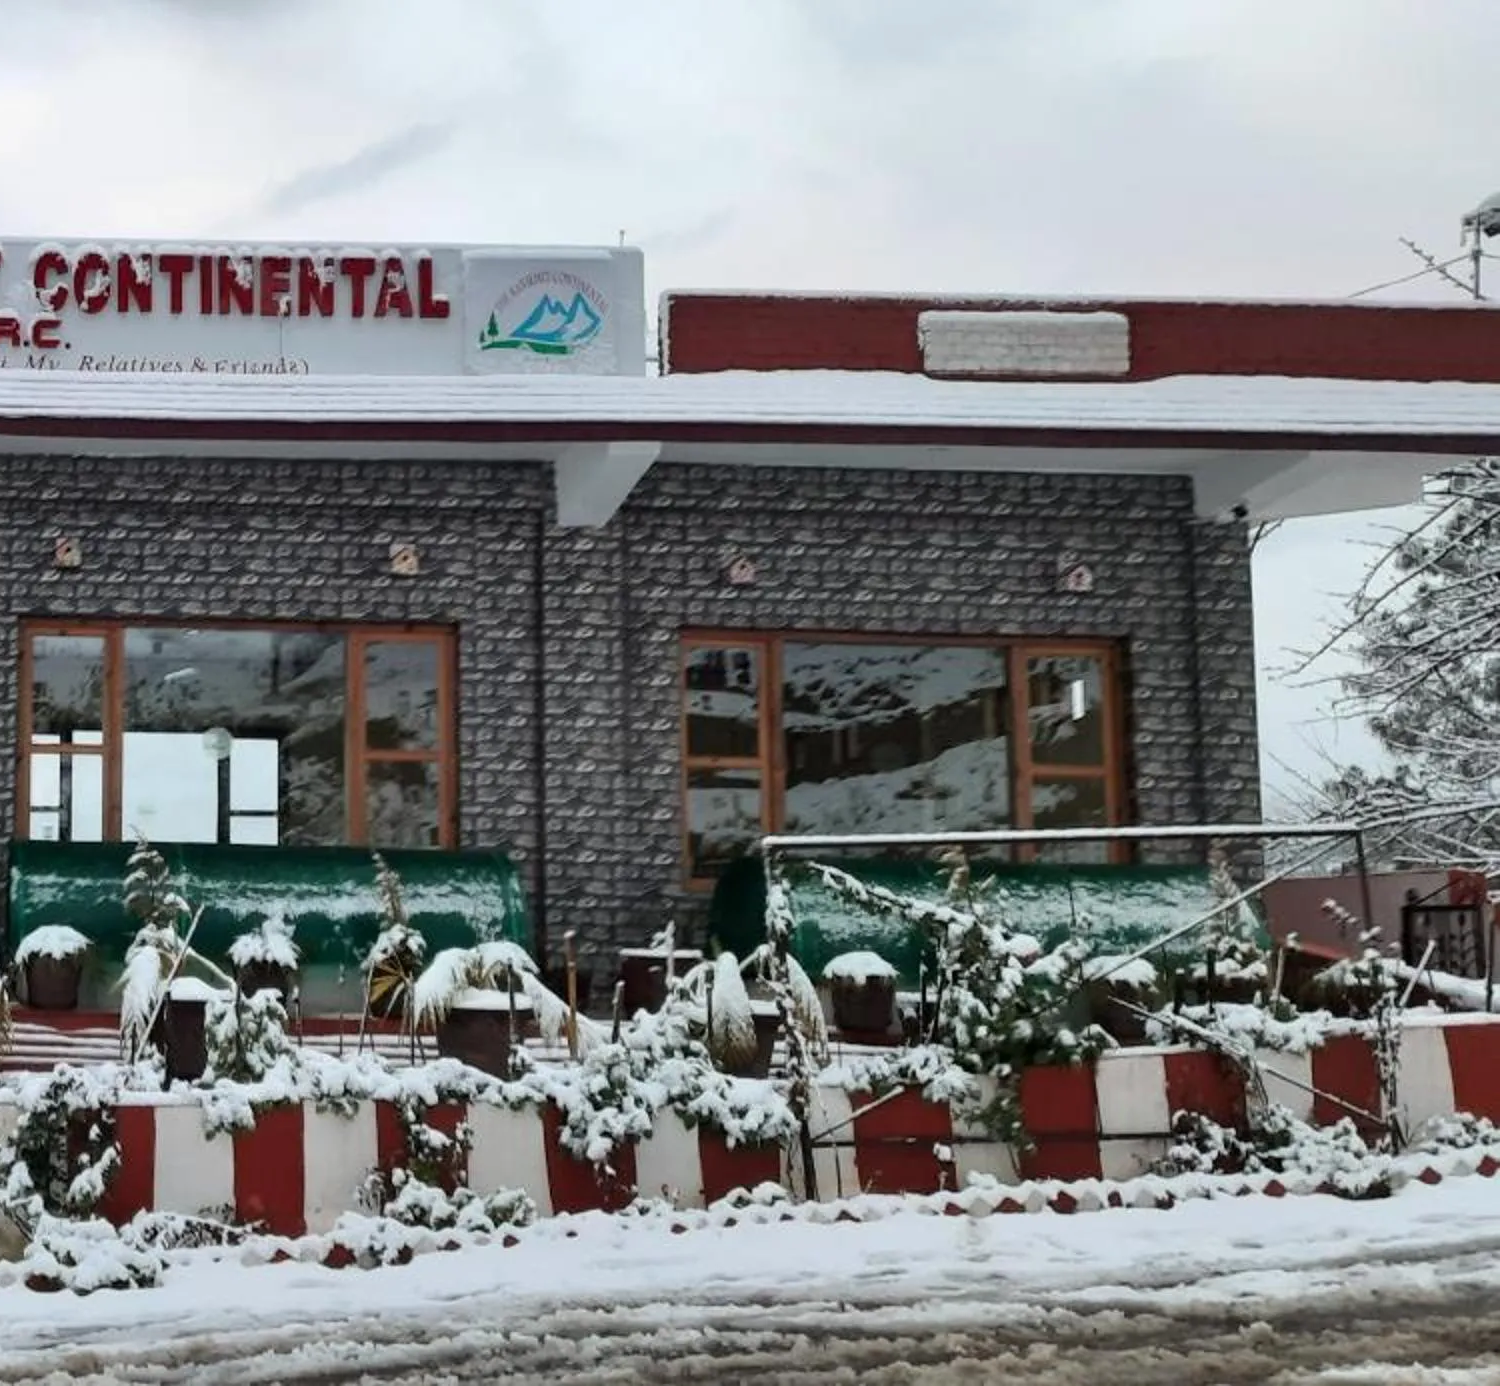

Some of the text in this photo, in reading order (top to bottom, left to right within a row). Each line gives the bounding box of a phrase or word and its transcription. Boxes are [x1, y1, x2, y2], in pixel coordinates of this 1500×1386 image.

[33, 251, 451, 318] CONTINENTAL
[78, 354, 183, 373] Relatives
[191, 356, 208, 372] &
